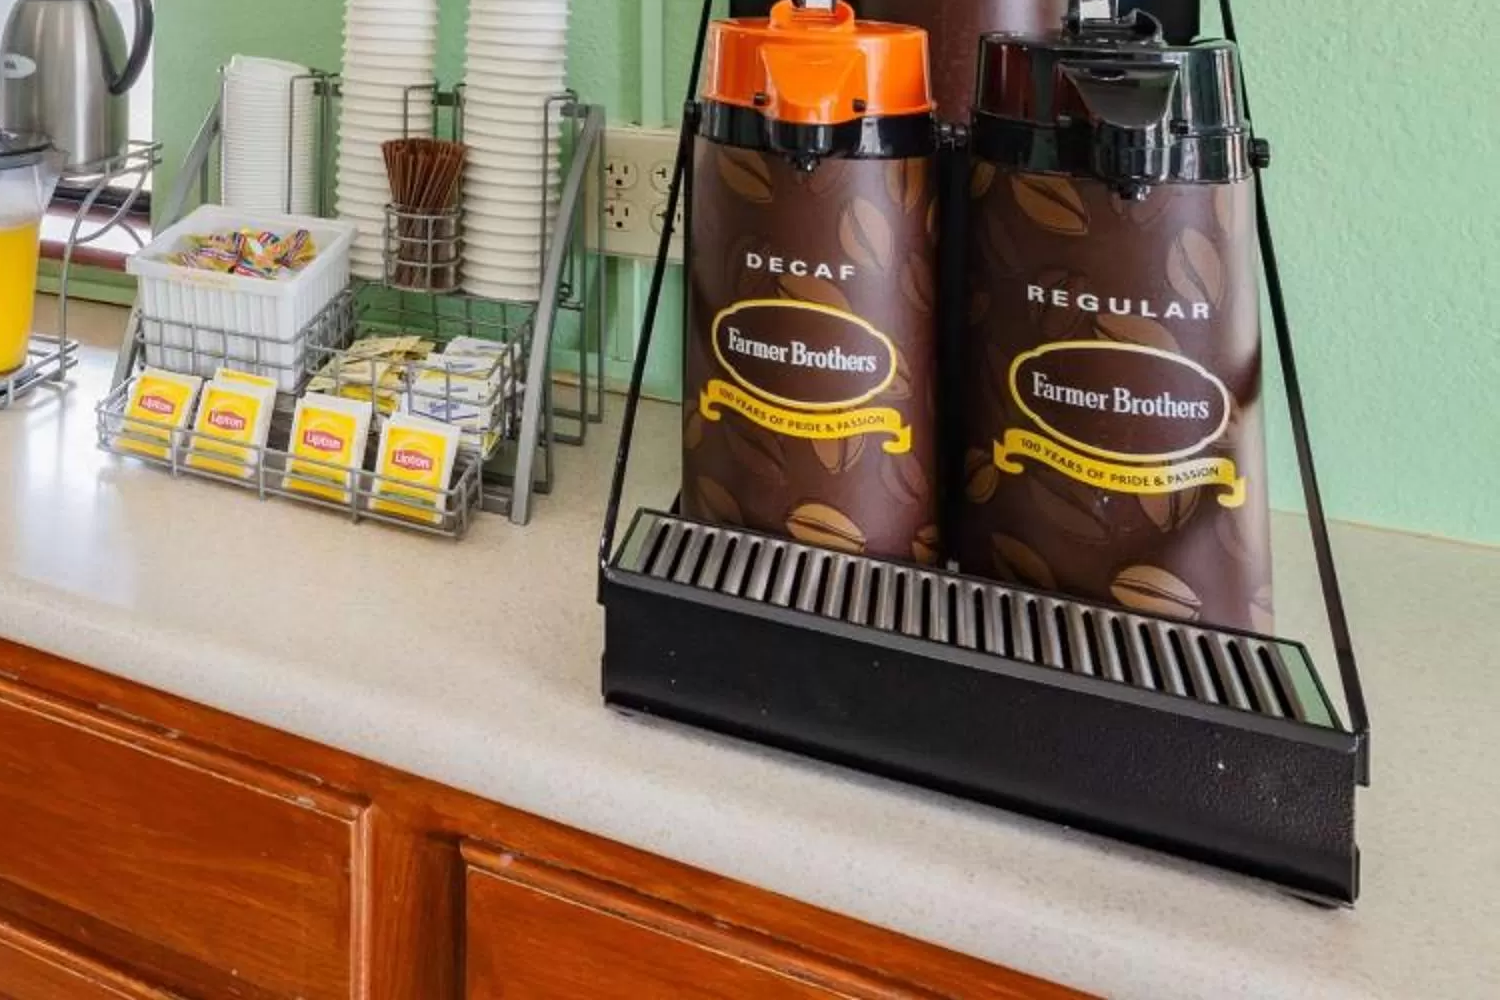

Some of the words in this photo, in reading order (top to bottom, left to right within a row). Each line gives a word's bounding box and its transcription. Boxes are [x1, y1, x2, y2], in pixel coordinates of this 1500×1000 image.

[745, 253, 855, 281] DECAF
[1027, 284, 1210, 320] REGULAR
[727, 326, 788, 363] Farmer
[790, 340, 877, 372] Brothers
[1032, 371, 1109, 410] Farmer
[1112, 387, 1210, 419] Brothers
[736, 397, 766, 421] YEARS
[769, 415, 785, 425] OF
[787, 420, 823, 433] PRIDE
[837, 415, 886, 432] PASSION
[395, 449, 431, 470] Lipton
[1019, 437, 1041, 452] 100
[1043, 447, 1083, 473] YEARS
[1086, 467, 1104, 480] OF
[1109, 473, 1151, 487] PRIDE
[1153, 476, 1165, 487] &
[1167, 466, 1220, 484] PASSION
